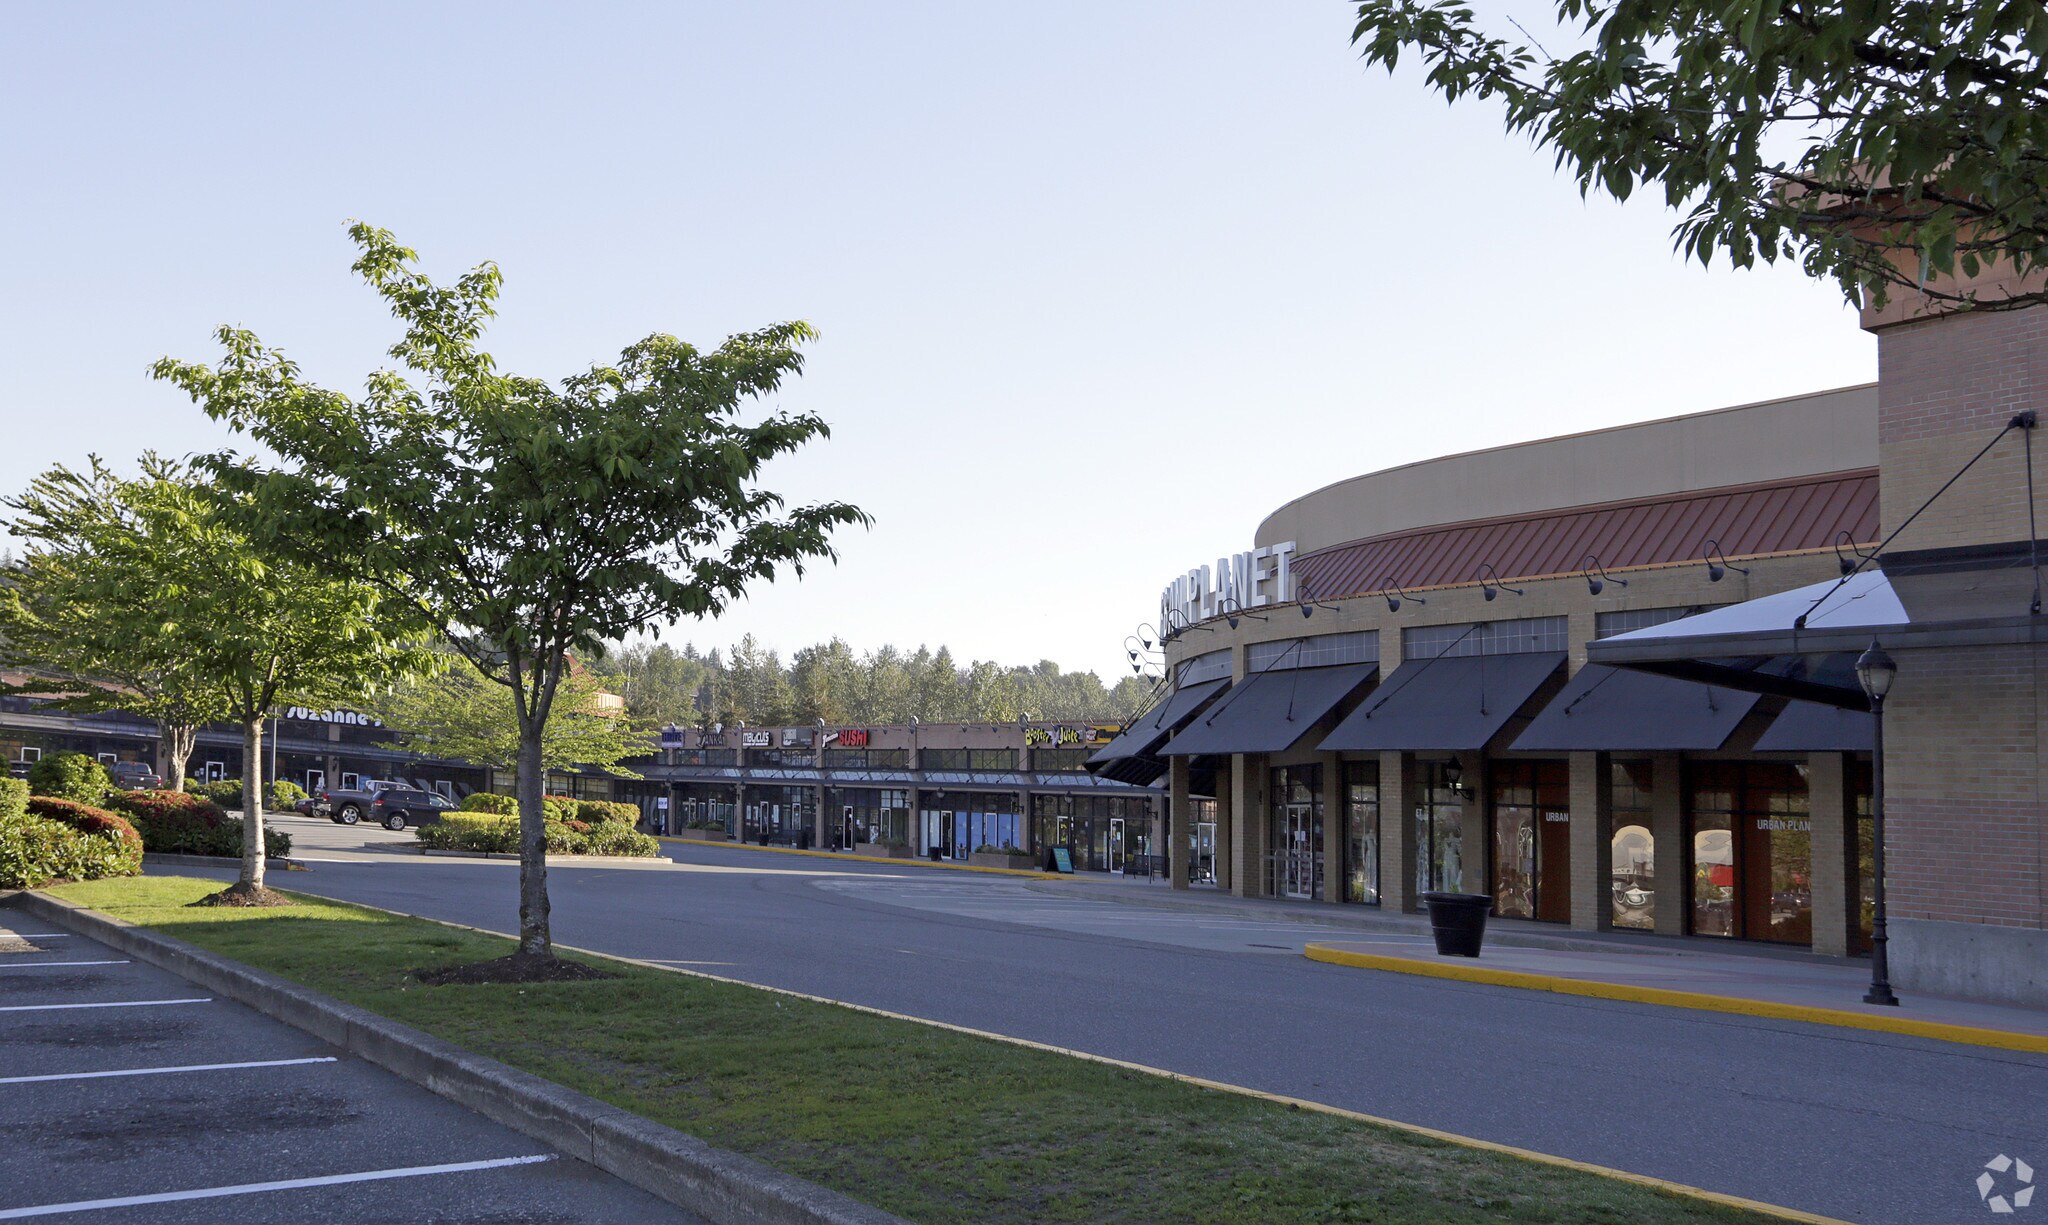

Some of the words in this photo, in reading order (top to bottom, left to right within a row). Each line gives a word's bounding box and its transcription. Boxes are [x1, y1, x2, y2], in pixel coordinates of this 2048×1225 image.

[1188, 541, 1296, 623] PLANET
[286, 706, 382, 727] suzannes
[1545, 812, 1568, 821] URBAN
[1757, 820, 1785, 830] URBAN
